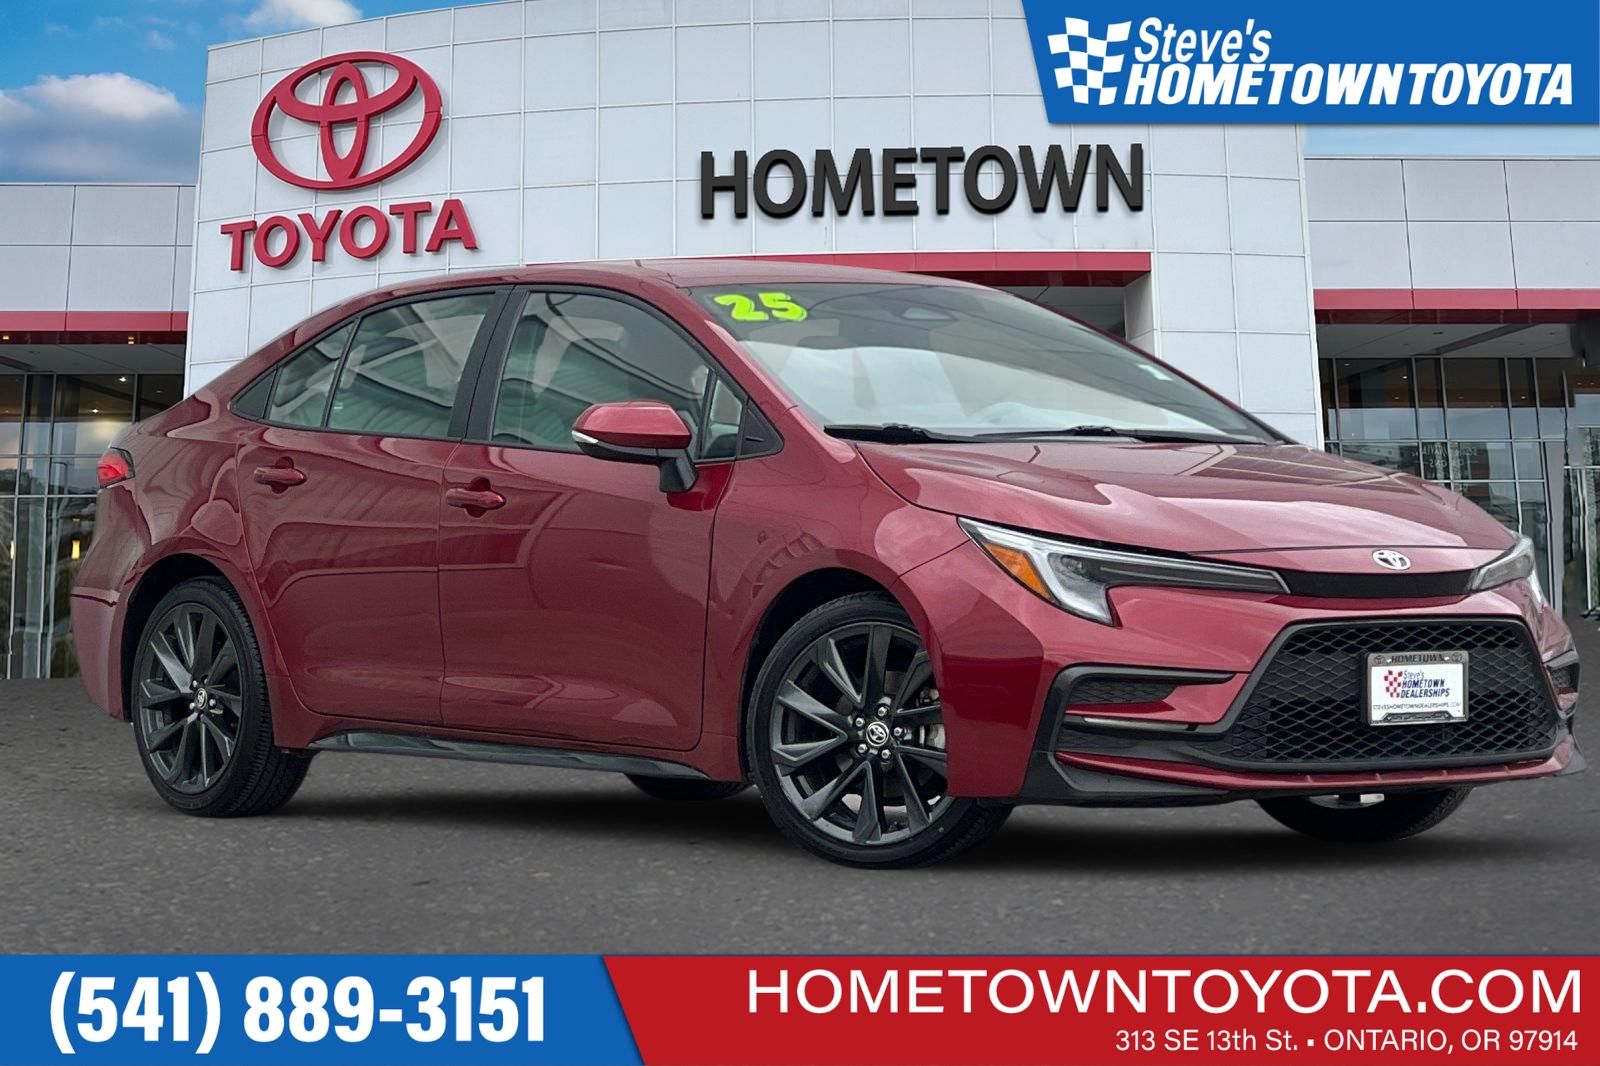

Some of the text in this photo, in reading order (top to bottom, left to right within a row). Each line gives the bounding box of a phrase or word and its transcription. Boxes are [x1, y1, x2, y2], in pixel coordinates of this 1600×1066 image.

[701, 144, 1143, 219] HOMETOWN
[221, 199, 477, 270] TOYOTA
[714, 292, 808, 321] 25
[1391, 654, 1445, 663] HOMETOWN
[1403, 669, 1425, 680] Steve's
[1402, 679, 1445, 688] HOMETOWN
[1400, 688, 1450, 698] DEALERSHIPS
